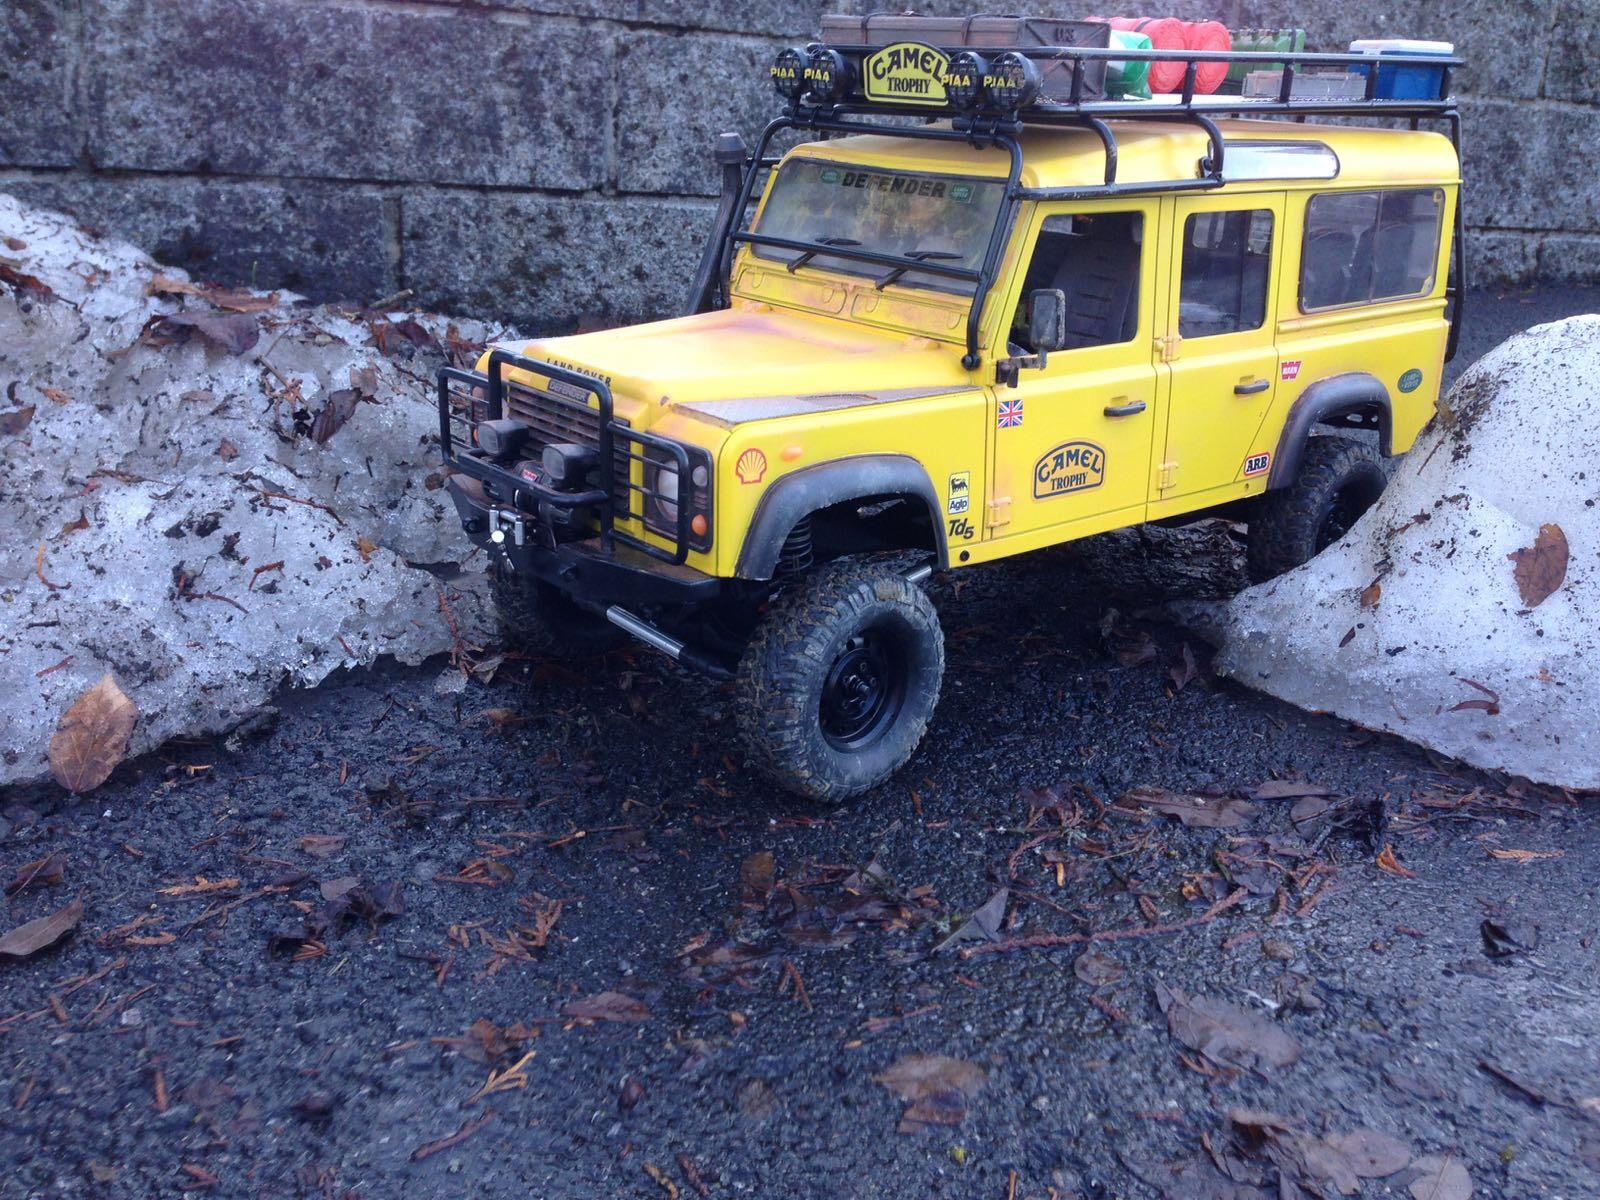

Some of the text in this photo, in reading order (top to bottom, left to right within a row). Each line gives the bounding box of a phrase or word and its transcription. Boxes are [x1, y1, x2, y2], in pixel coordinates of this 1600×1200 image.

[770, 67, 796, 79] PIAA
[872, 49, 949, 82] CAMEL
[804, 68, 830, 82] PIAA
[941, 74, 971, 88] PIAA
[983, 76, 1016, 88] PIAA
[887, 76, 932, 95] TROPHY
[1037, 448, 1101, 483] CAMEL
[1245, 456, 1269, 473] ARB
[1050, 472, 1089, 491] TROPHY
[948, 518, 975, 540] Td5
